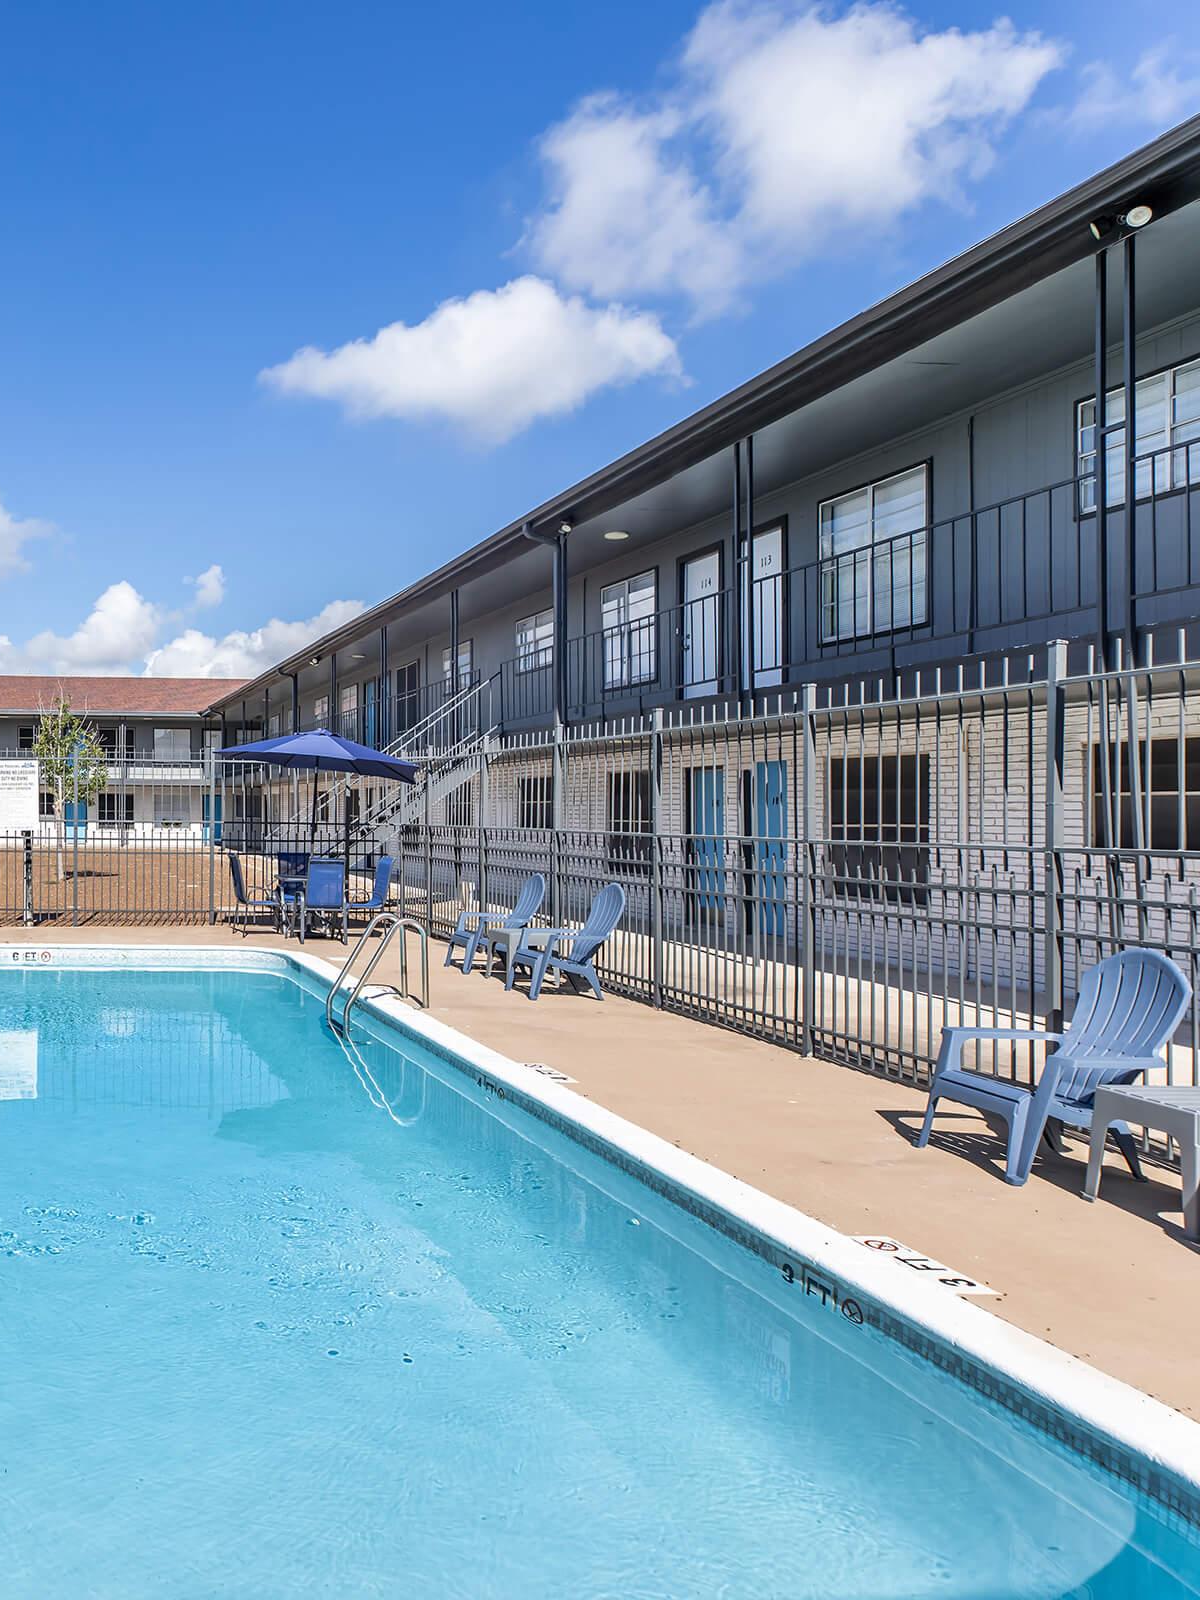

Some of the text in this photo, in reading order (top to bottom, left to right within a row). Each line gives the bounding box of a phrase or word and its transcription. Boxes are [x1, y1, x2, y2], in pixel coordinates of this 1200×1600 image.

[760, 555, 772, 568] 113
[701, 577, 712, 590] 114
[893, 1255, 977, 1287] 3 FT
[781, 1263, 832, 1306] 3 FT
